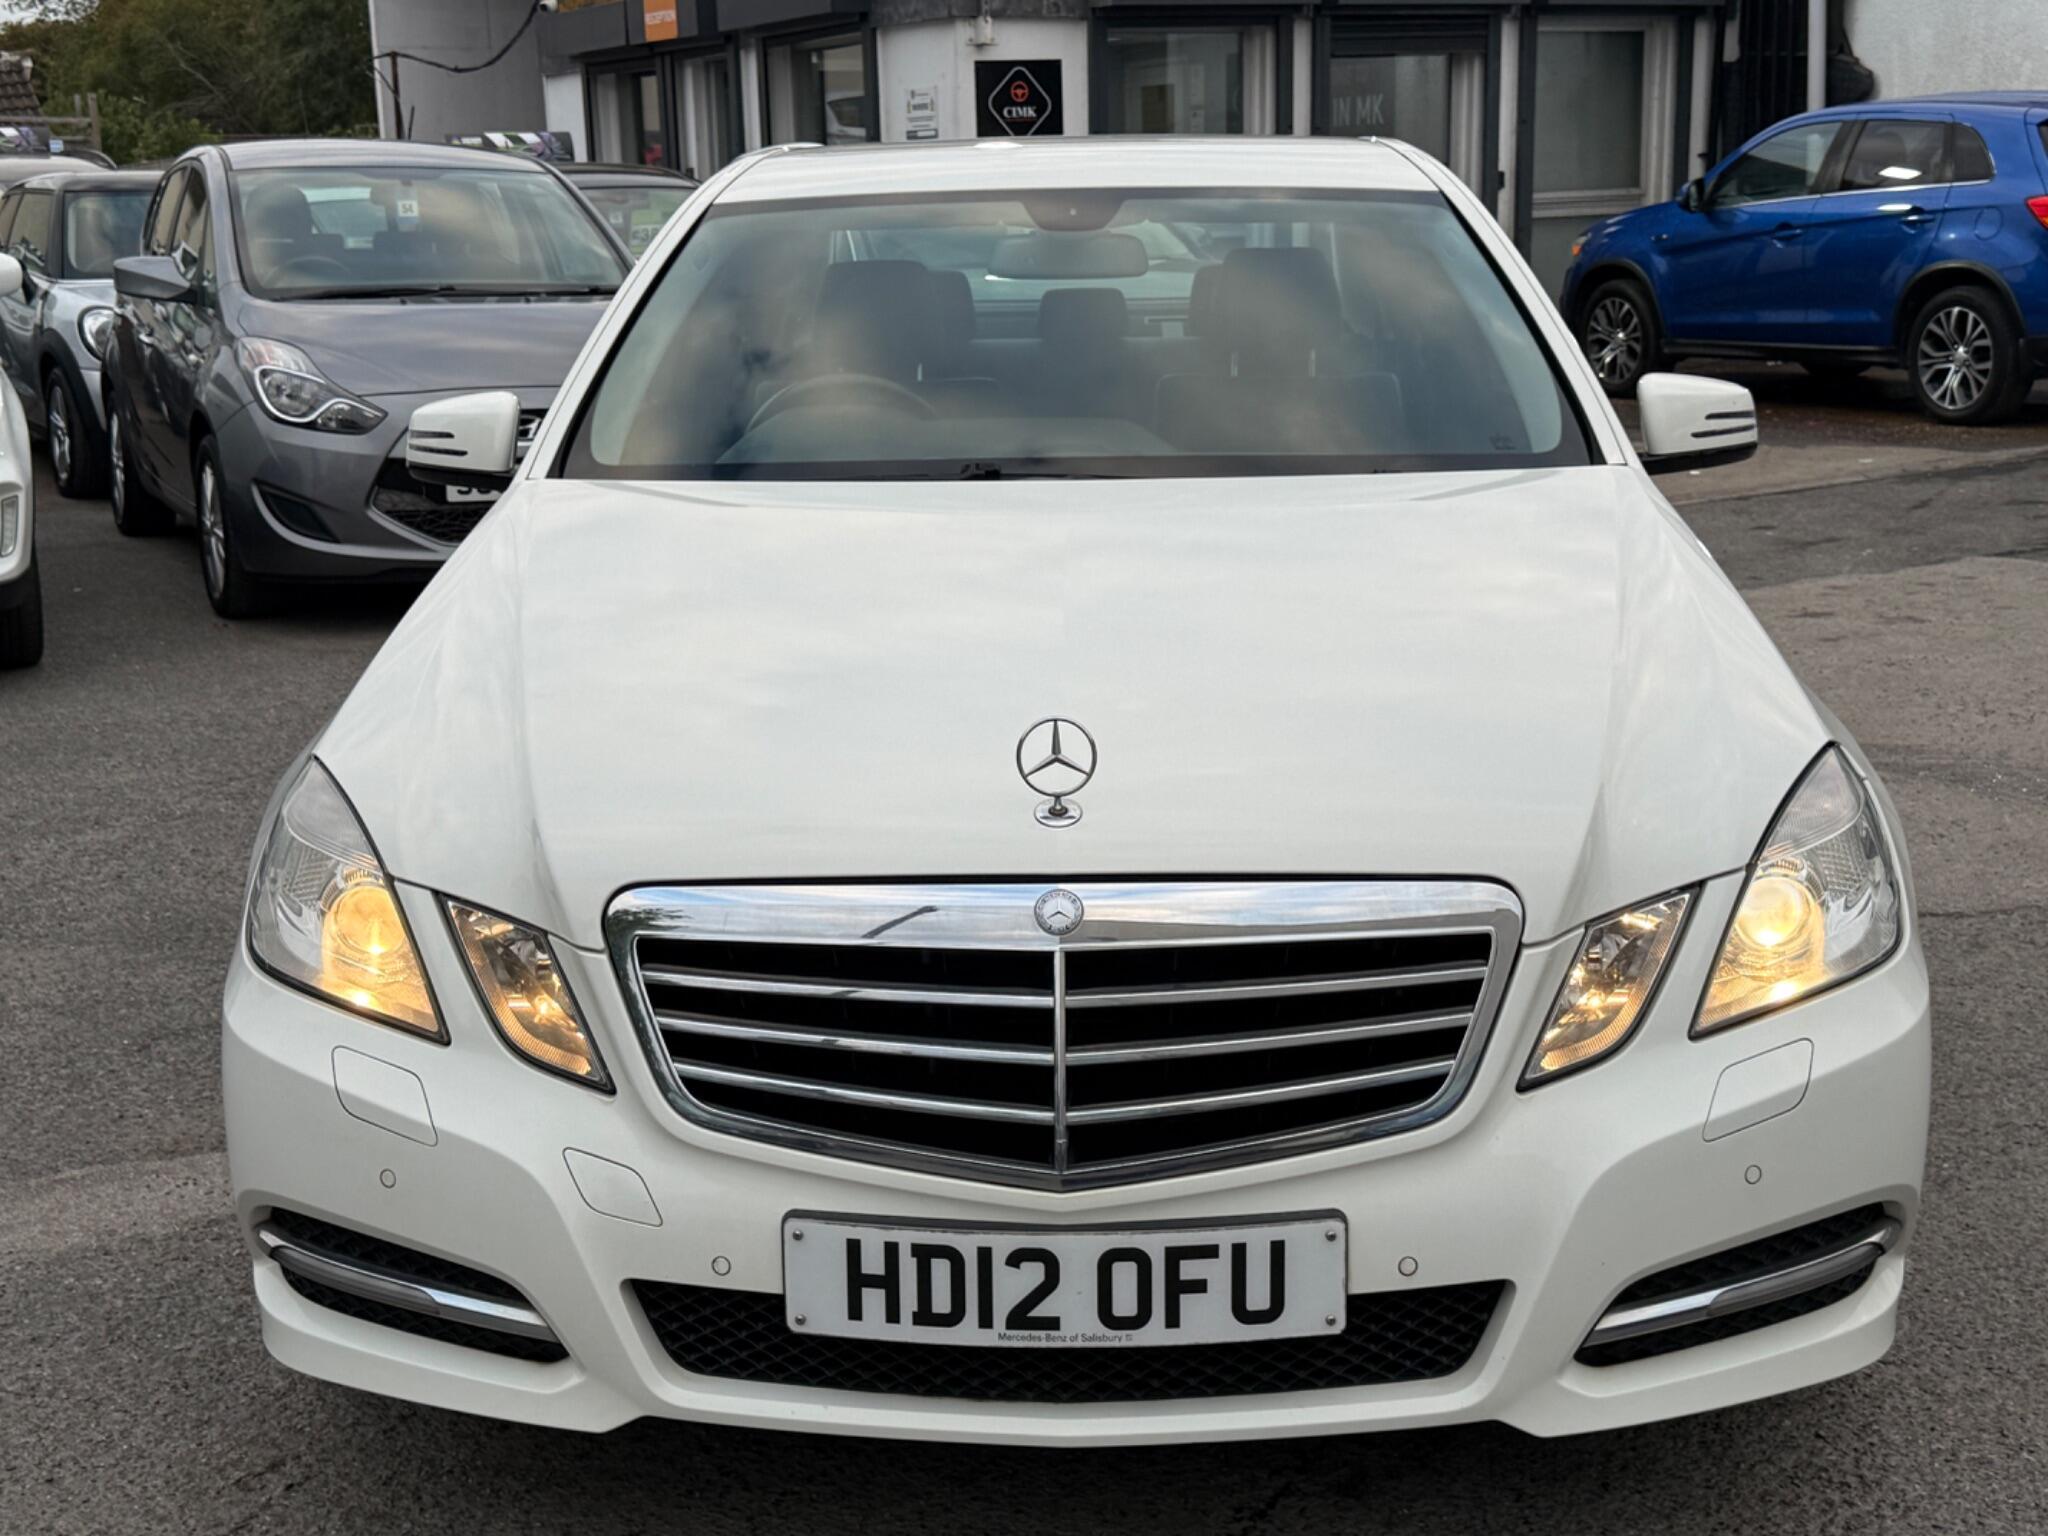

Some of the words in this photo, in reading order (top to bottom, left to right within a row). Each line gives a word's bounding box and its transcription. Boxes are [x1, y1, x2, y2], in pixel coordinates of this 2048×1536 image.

[1333, 97, 1350, 127] IN
[1356, 94, 1384, 126] MK
[846, 1238, 1061, 1332] HD12
[1097, 1239, 1285, 1330] OFU
[998, 1332, 1067, 1343] Mercedes-Benz
[1069, 1333, 1079, 1343] of
[1080, 1332, 1122, 1343] Salisbury
